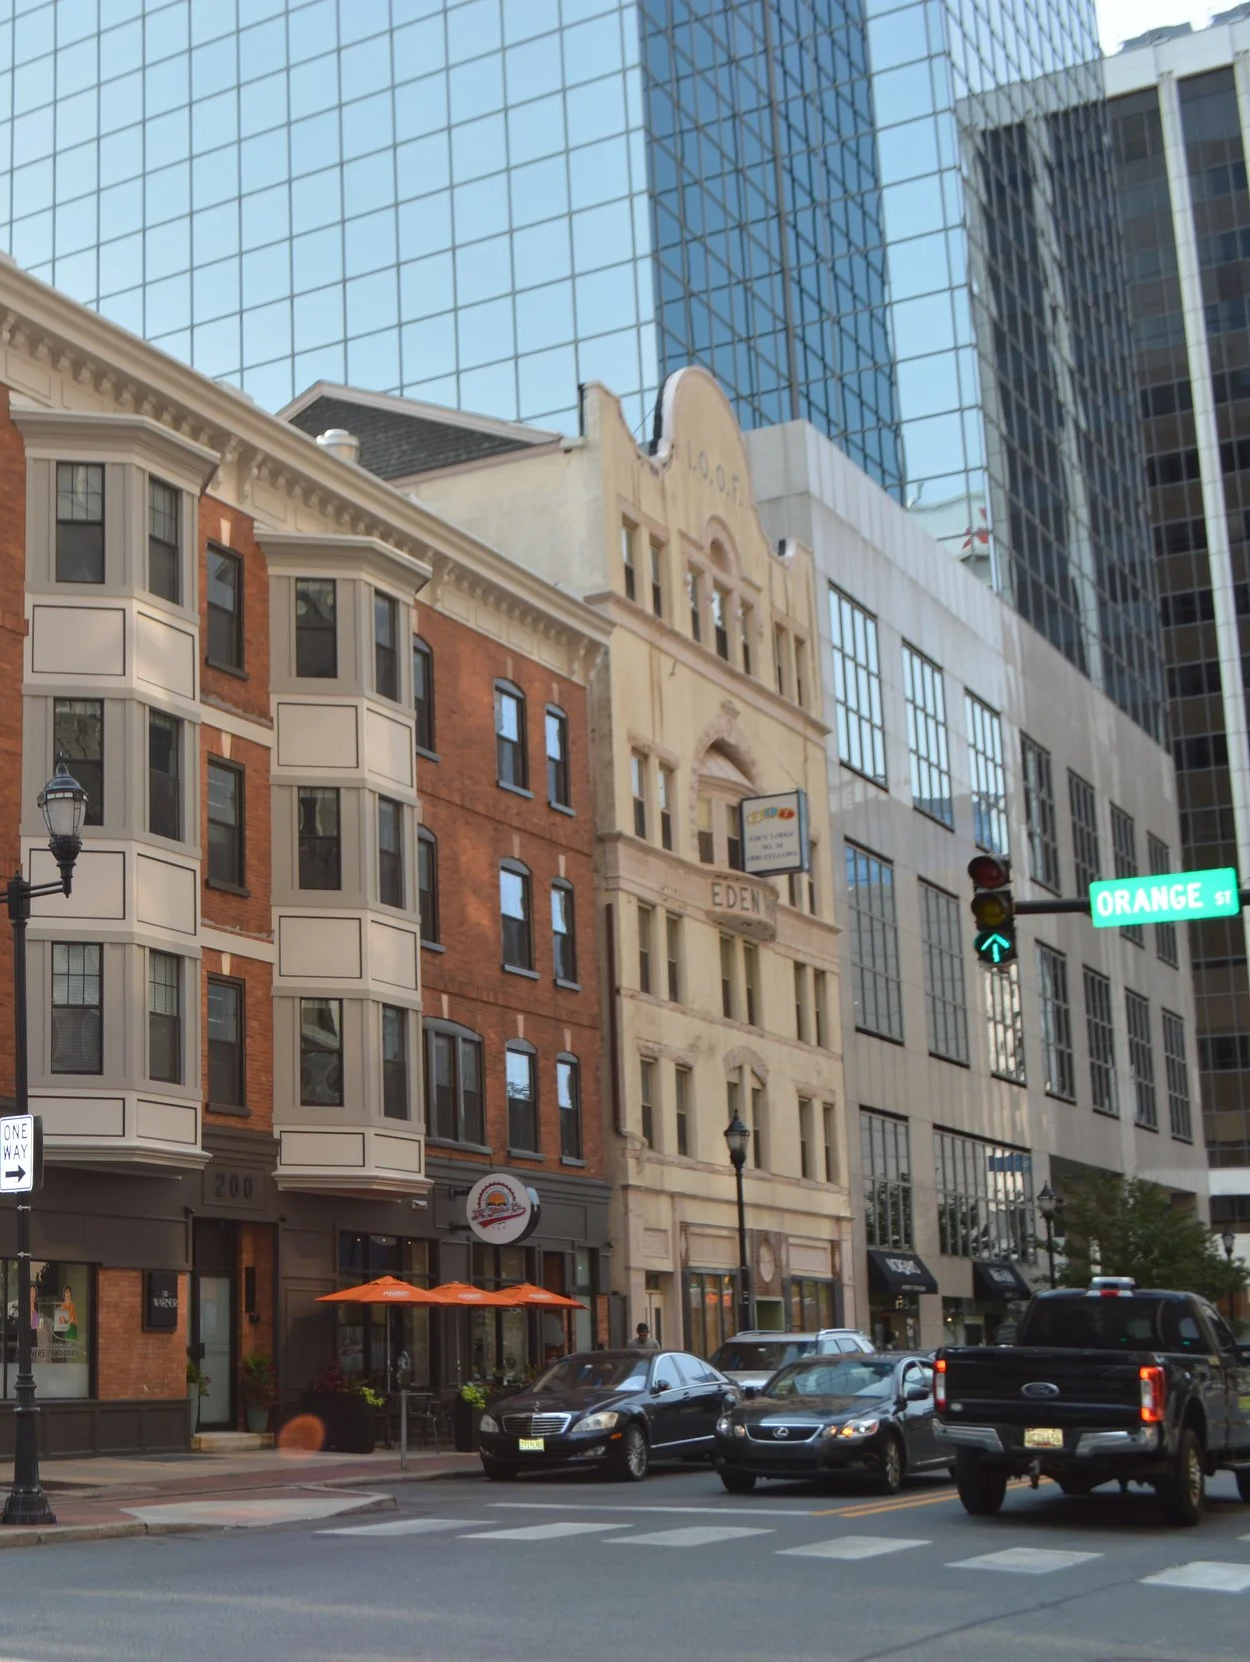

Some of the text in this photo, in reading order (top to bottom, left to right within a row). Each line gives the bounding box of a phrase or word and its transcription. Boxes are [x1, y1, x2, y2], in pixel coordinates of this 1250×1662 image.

[711, 882, 761, 914] EDEN
[1096, 882, 1232, 917] ORANGE ST
[3, 1123, 28, 1141] ONE
[3, 1143, 28, 1161] WAY
[215, 1172, 253, 1199] 200
